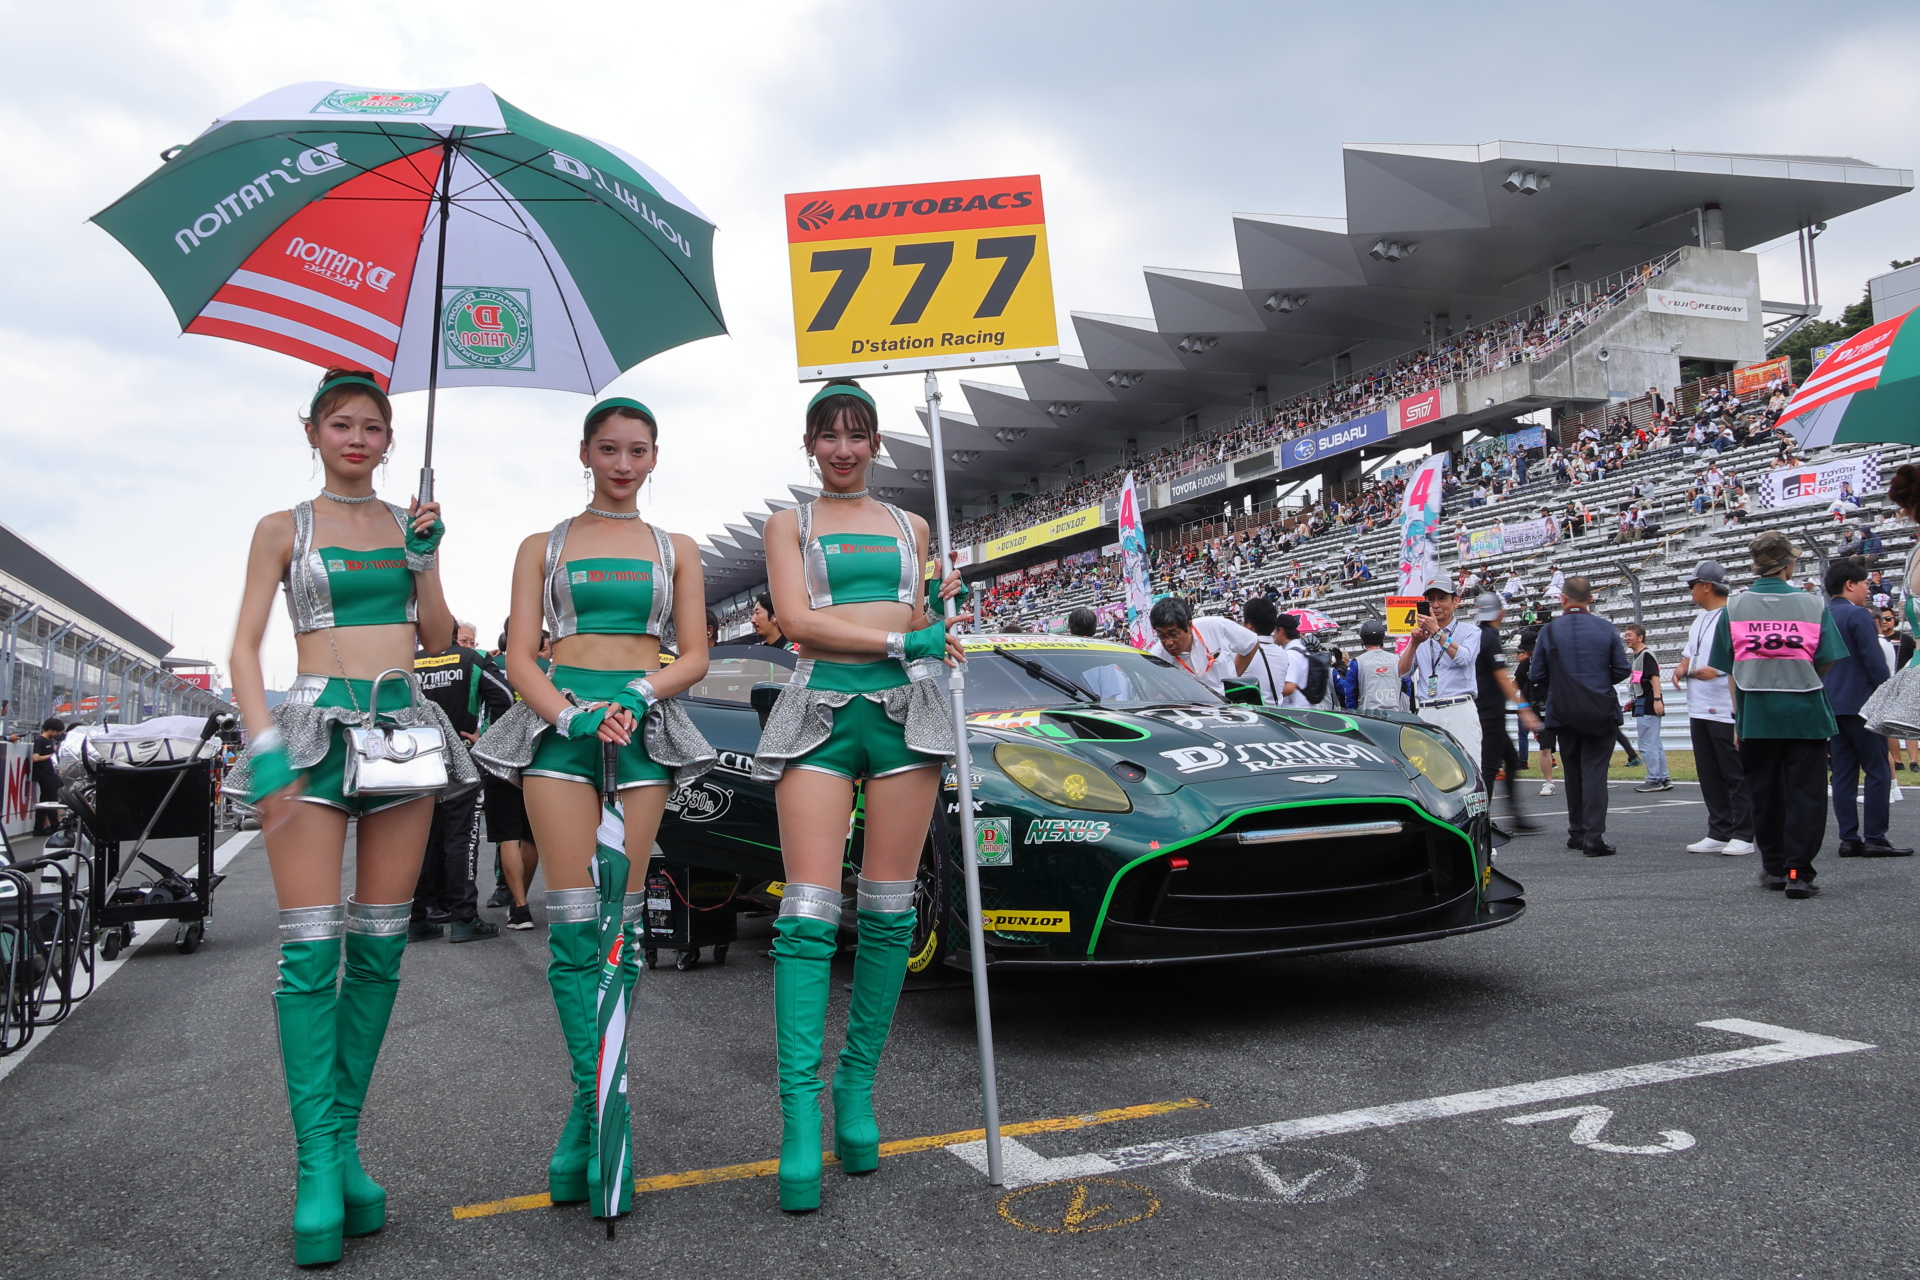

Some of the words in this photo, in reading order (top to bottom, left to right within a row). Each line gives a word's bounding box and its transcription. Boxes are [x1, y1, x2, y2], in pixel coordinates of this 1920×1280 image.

[837, 191, 1033, 222] AUTOBACS
[806, 235, 1037, 333] 777
[1668, 300, 1689, 308] FUJI
[1689, 300, 1744, 313] SPEEDWAY
[851, 338, 934, 354] D'station
[941, 330, 1005, 347] Racing
[1318, 424, 1367, 450] SUBARU
[1820, 465, 1856, 478] TOYOTA
[1172, 481, 1197, 497] TOYOTA
[1197, 471, 1226, 488] FUDOSAN
[1819, 474, 1854, 486] GAZOO
[1409, 468, 1435, 511] 4
[1784, 482, 1816, 500] GR
[1055, 516, 1086, 534] DUNLOP
[840, 543, 898, 554] D'STATION
[1001, 535, 1027, 551] DUNLOP
[345, 559, 408, 571] D'STATION
[588, 570, 651, 582] D'STATION
[1404, 609, 1417, 627] 4
[1748, 622, 1799, 632] MEDIA
[962, 642, 1017, 650] seven
[1745, 633, 1804, 651] 388
[421, 656, 458, 665] DUNLOP
[1375, 688, 1396, 701] 075
[1158, 741, 1385, 774] D'STATION
[1241, 758, 1360, 773] RACING
[1024, 819, 1111, 845] NEXUS
[980, 844, 1003, 853] STATION
[995, 916, 1064, 926] DUNLOP
